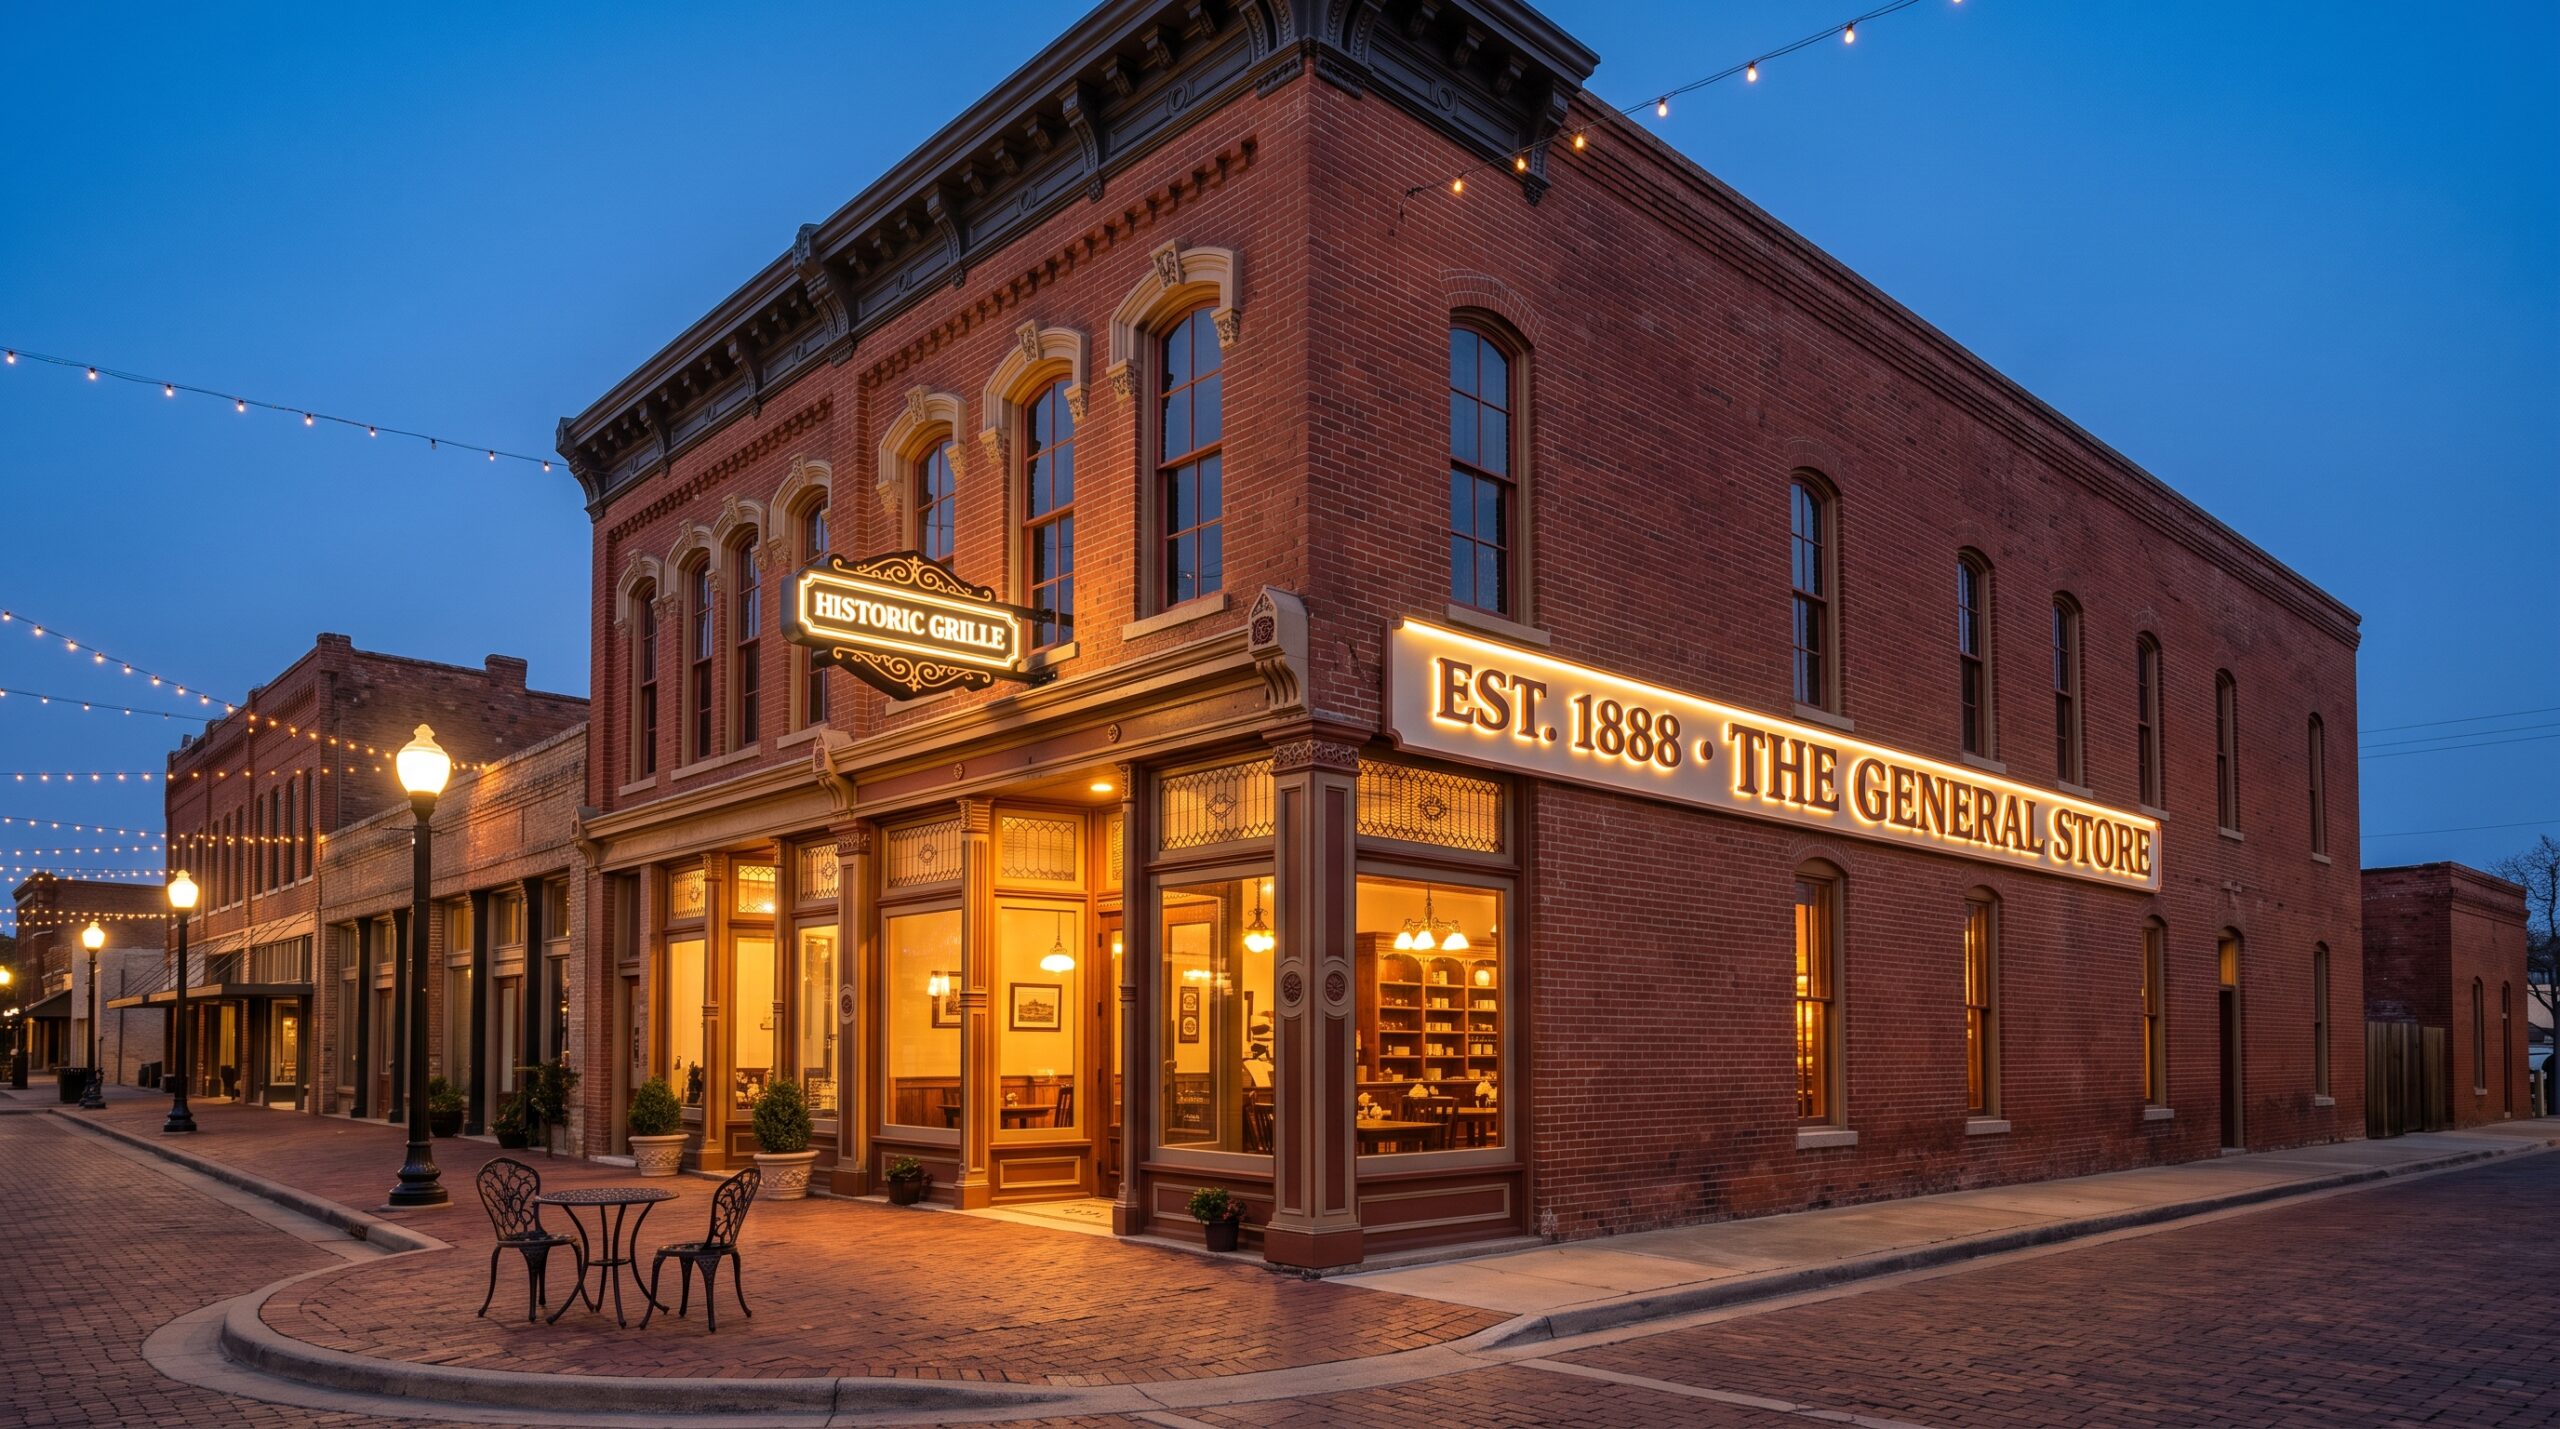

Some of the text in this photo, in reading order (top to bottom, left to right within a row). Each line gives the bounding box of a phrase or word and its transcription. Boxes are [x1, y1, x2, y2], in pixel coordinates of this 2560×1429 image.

[814, 591, 1005, 650] HISTORIC GRILLE
[1436, 657, 1557, 742] EST.
[1573, 694, 1682, 768] 1888
[1728, 722, 1840, 812] THE
[1853, 758, 2045, 855] GENERAL
[2053, 808, 2152, 877] STORE
